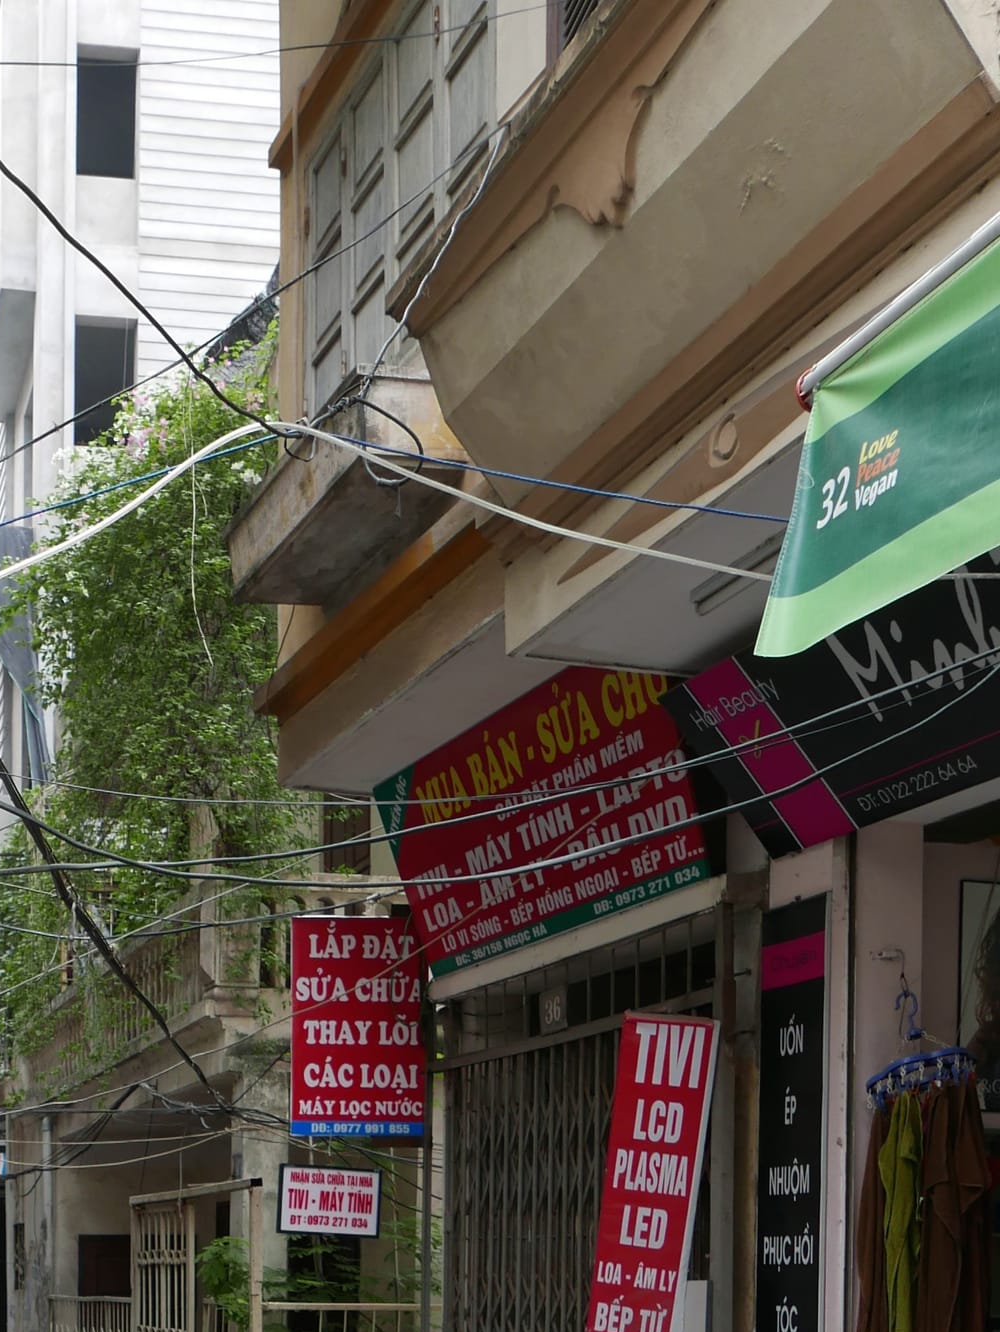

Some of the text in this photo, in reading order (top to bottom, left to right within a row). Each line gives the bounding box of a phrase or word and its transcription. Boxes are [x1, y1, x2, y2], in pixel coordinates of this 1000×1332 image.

[856, 448, 900, 488] Peace
[859, 429, 899, 464] Love
[817, 466, 850, 529] 32
[855, 469, 898, 510] Vegan
[689, 679, 779, 731] Hair Beauty
[416, 766, 471, 824] MUA
[467, 730, 524, 797] BÁN
[536, 682, 600, 763] SỬA
[552, 754, 598, 791] PHẦN
[600, 730, 643, 768] MỀM
[878, 782, 912, 804] 0122
[910, 771, 939, 791] 222
[938, 763, 957, 781] 64
[957, 755, 978, 773] 64
[414, 864, 450, 900] TIVI
[465, 834, 512, 875] MÁY
[516, 802, 574, 851] TÍNH
[423, 897, 463, 932] LOA
[479, 876, 515, 909] ÂM
[519, 857, 544, 892] LY
[456, 929, 470, 946] VI
[470, 916, 501, 942] SÓNG
[510, 898, 534, 926] BẾP
[536, 887, 573, 915] HỒNG
[574, 867, 619, 900] NGOẠI
[631, 845, 661, 877] BẾP
[615, 886, 645, 906] 0973
[647, 876, 670, 895] 271
[674, 866, 700, 884] 034
[309, 921, 414, 964] LẮP ĐẶT
[504, 930, 531, 948] NGỌC
[296, 967, 420, 1002] SỬA CHỮA
[303, 1014, 418, 1045] THAY LÕI
[545, 995, 561, 1025] 36
[635, 1022, 706, 1088] TIVI
[780, 1013, 804, 1056] UỐN
[303, 1056, 418, 1094] CÁC LOẠI
[299, 1096, 423, 1119] MÁY LỌC NƯỚC
[633, 1098, 684, 1144] LCD
[784, 1086, 797, 1125] ÉP
[333, 1123, 361, 1133] 0977
[365, 1123, 385, 1134] 991
[613, 1148, 688, 1197] PLASMA
[769, 1157, 810, 1202] NHUỘM
[288, 1188, 309, 1210] TIVI
[319, 1186, 344, 1212] MÁY
[348, 1190, 373, 1214] TÍNH
[332, 1217, 348, 1227] 271
[351, 1217, 368, 1228] 034
[619, 1205, 668, 1249] LED
[763, 1222, 813, 1272] PHỤC HỒI
[597, 1260, 621, 1285] LOA
[633, 1261, 657, 1290] ÂM
[659, 1269, 676, 1292] LY
